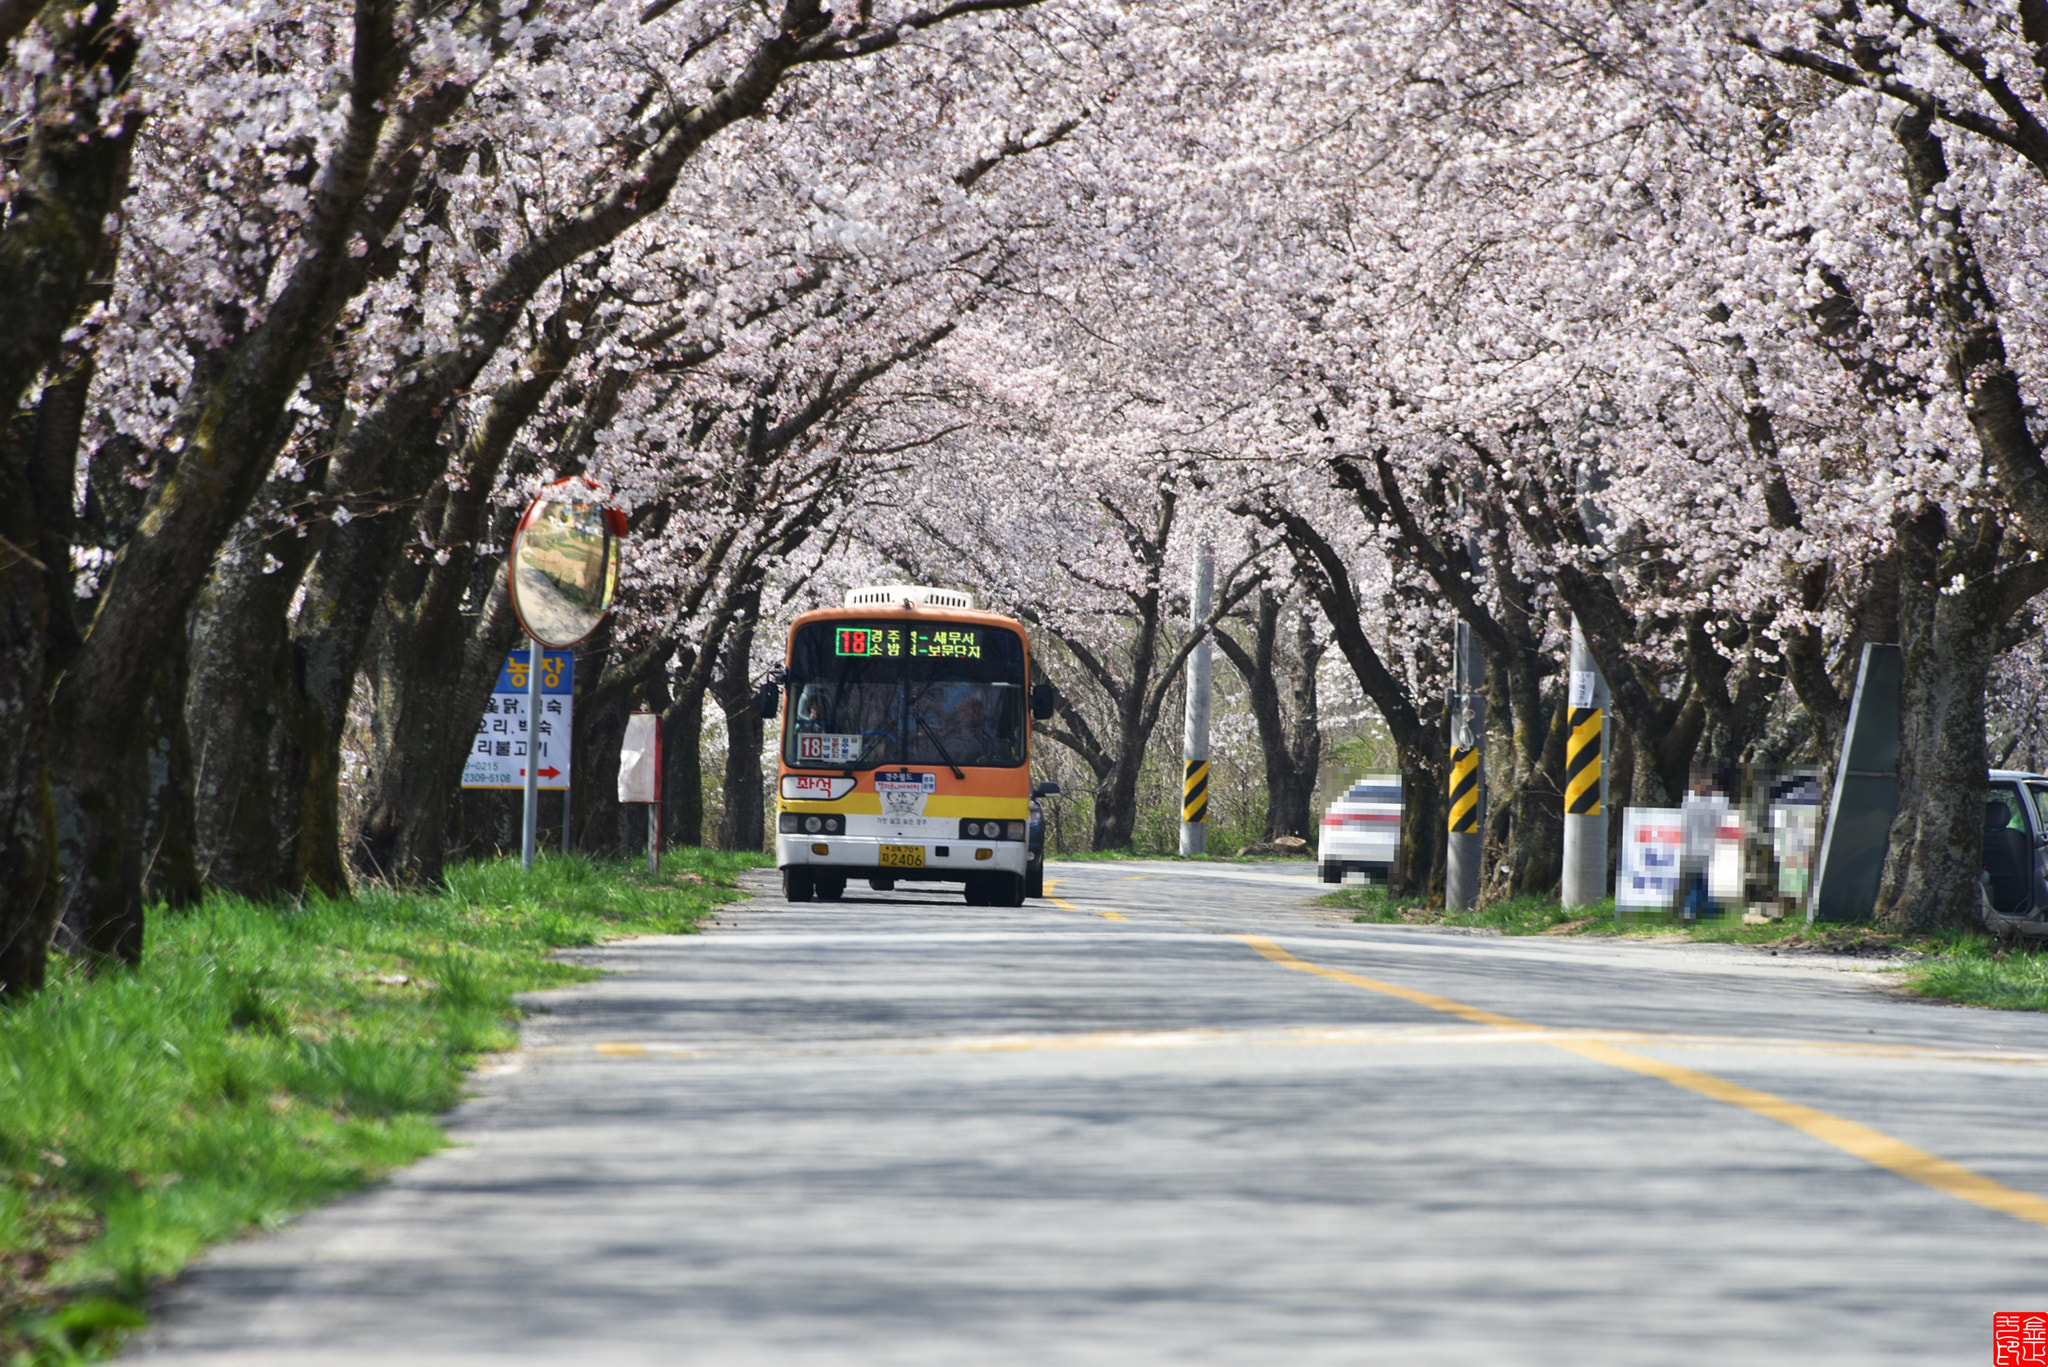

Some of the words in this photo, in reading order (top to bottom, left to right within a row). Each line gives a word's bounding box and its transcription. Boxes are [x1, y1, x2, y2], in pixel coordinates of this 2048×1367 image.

[841, 631, 867, 654] 18
[933, 632, 974, 645] 세무서
[928, 646, 980, 659] 보문단지
[470, 740, 547, 757] 리불고기
[803, 738, 821, 757] 18
[796, 777, 831, 798] 좌석
[891, 853, 923, 866] 2406
